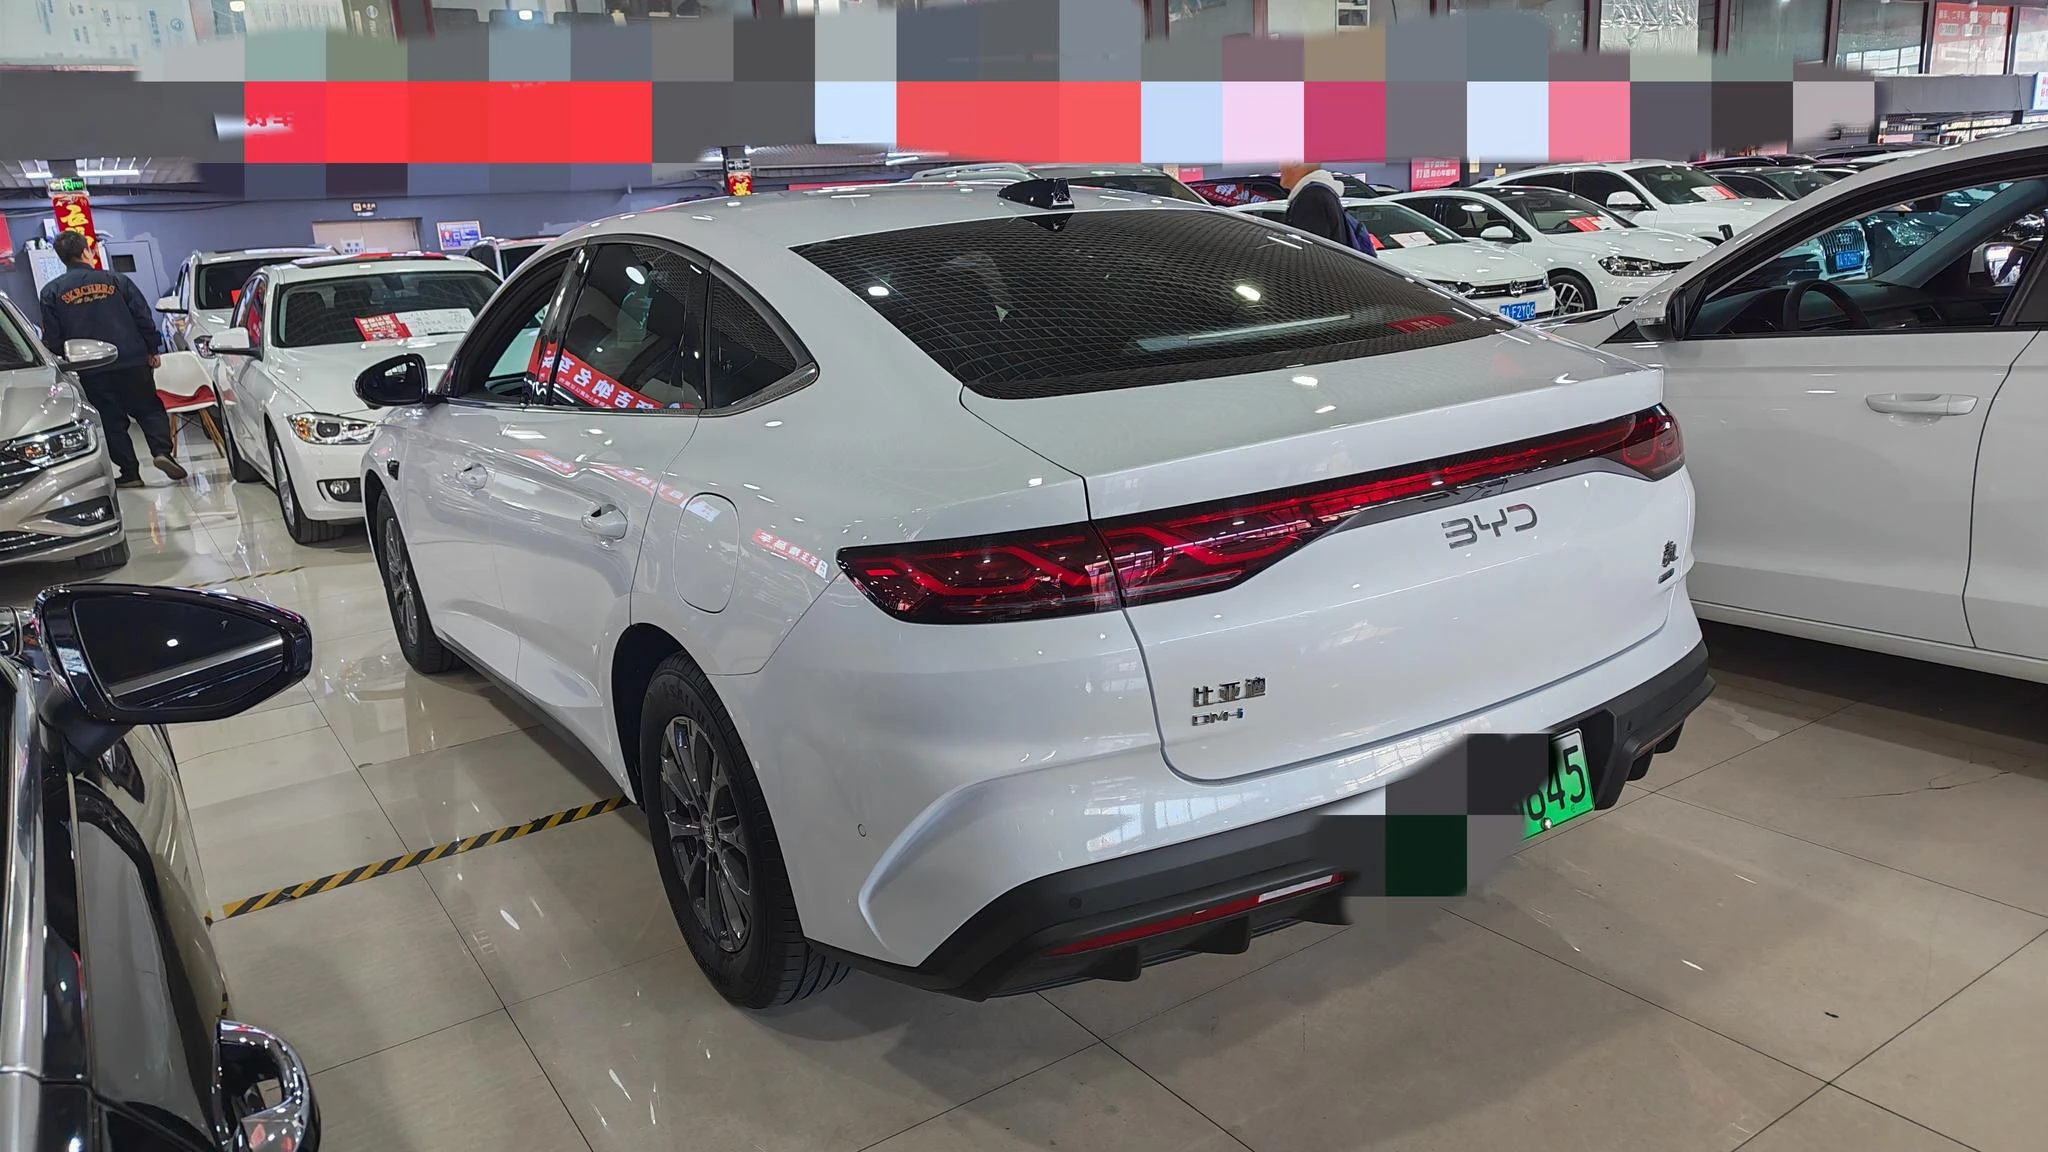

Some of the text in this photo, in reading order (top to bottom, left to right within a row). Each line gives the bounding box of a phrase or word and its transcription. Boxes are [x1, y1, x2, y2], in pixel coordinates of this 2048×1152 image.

[61, 283, 115, 304] SKECHERS
[1441, 503, 1538, 549] BYD
[1191, 676, 1266, 708] 比亚迪
